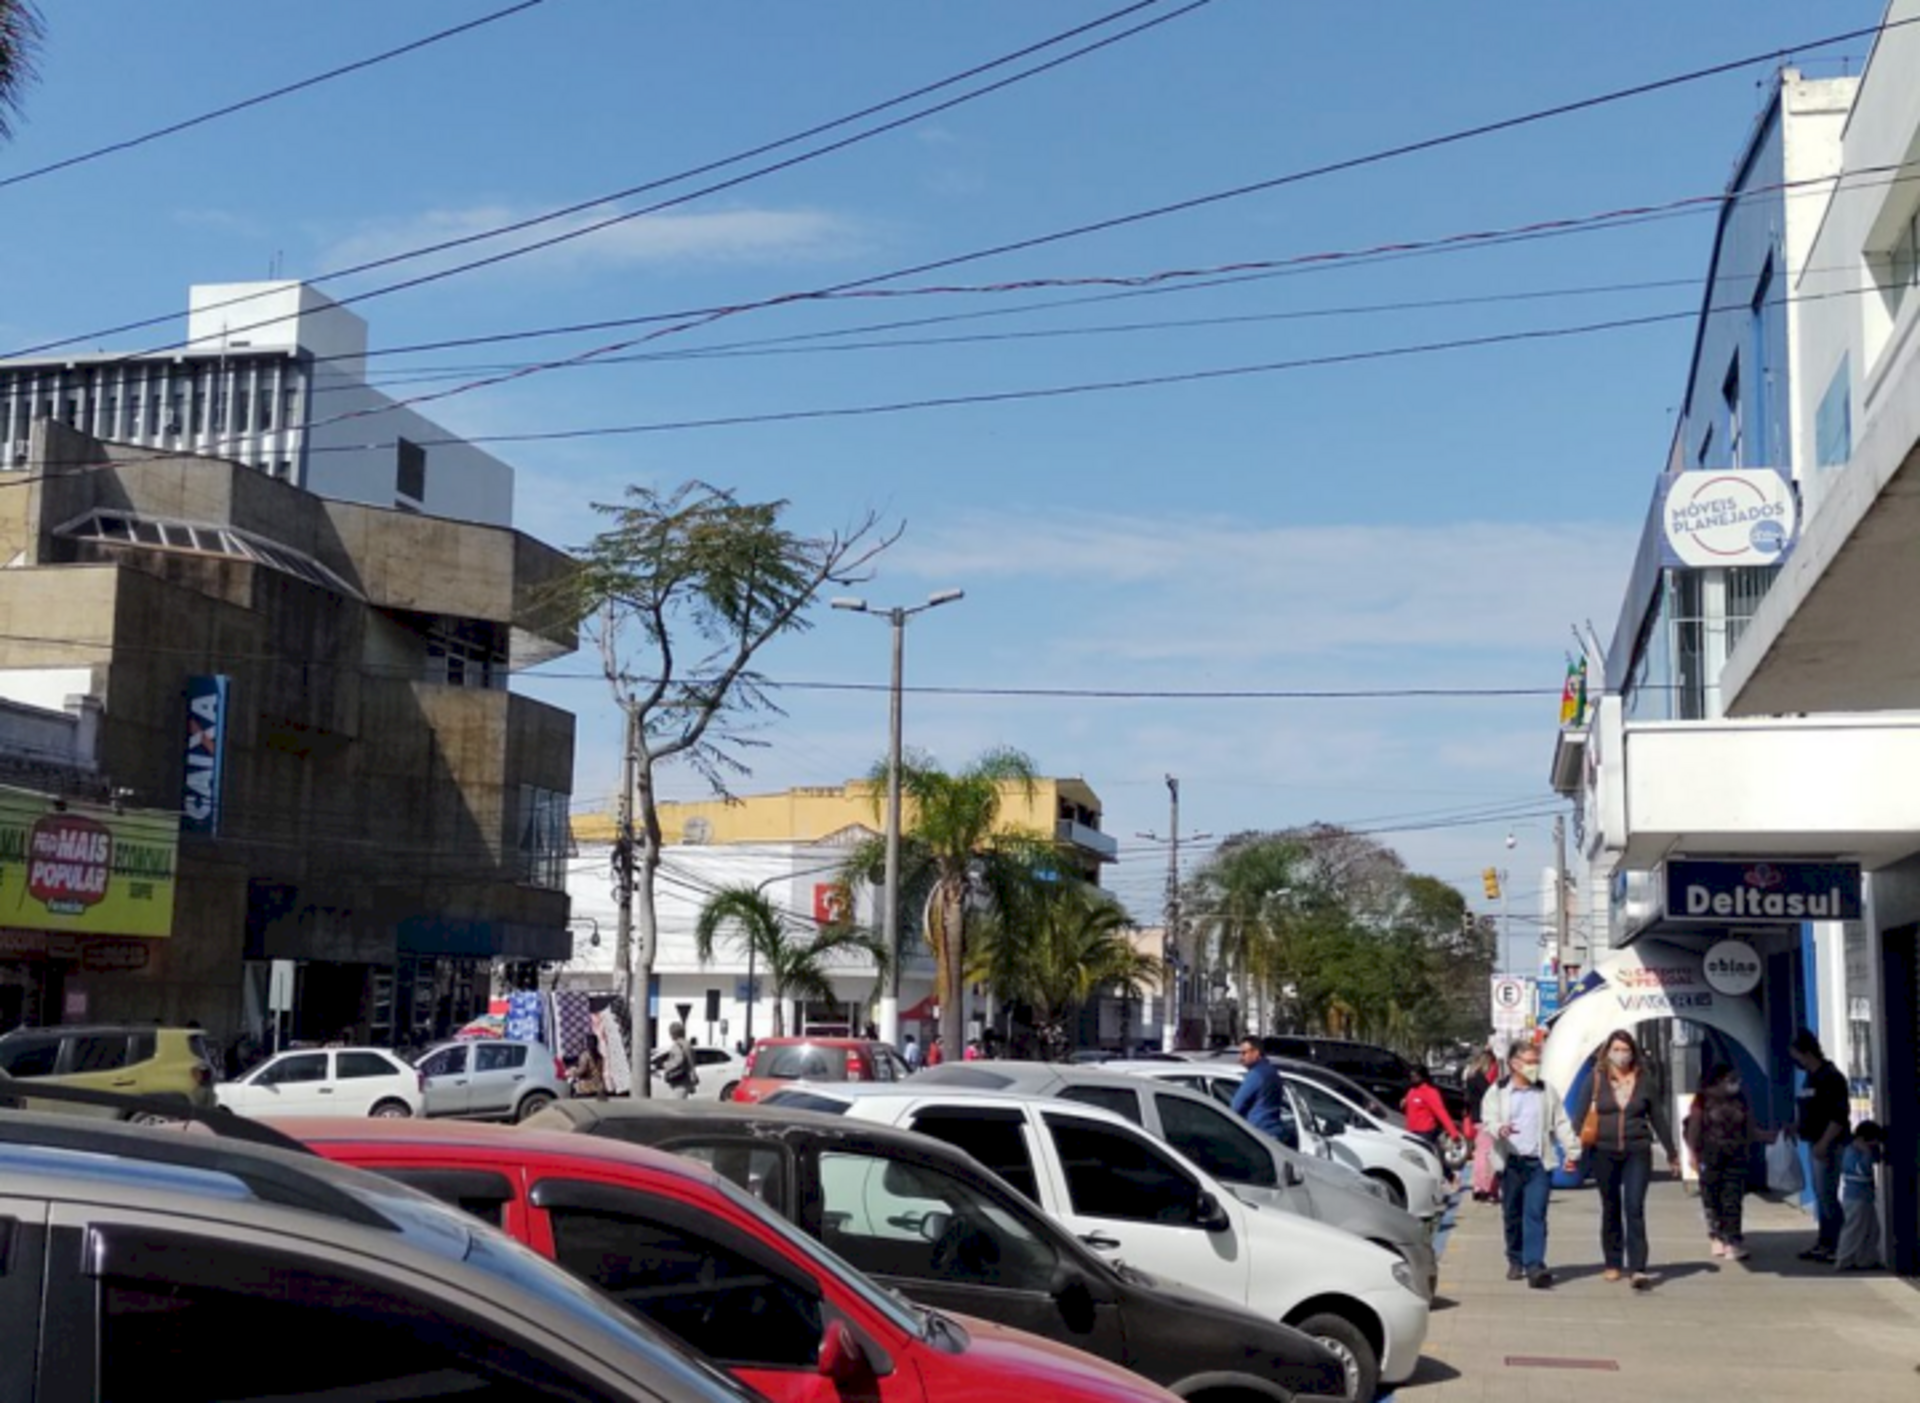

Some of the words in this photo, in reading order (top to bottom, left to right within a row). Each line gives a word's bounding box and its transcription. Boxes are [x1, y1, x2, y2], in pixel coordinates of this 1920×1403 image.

[1673, 497, 1737, 520] MÓVEIS
[1674, 502, 1785, 534] PLANEJADOS
[185, 693, 218, 820] CAIXA
[57, 828, 109, 861] MAIS
[31, 861, 104, 893] POPULAR
[1686, 884, 1841, 917] Deltasul
[1503, 985, 1513, 1002] E
